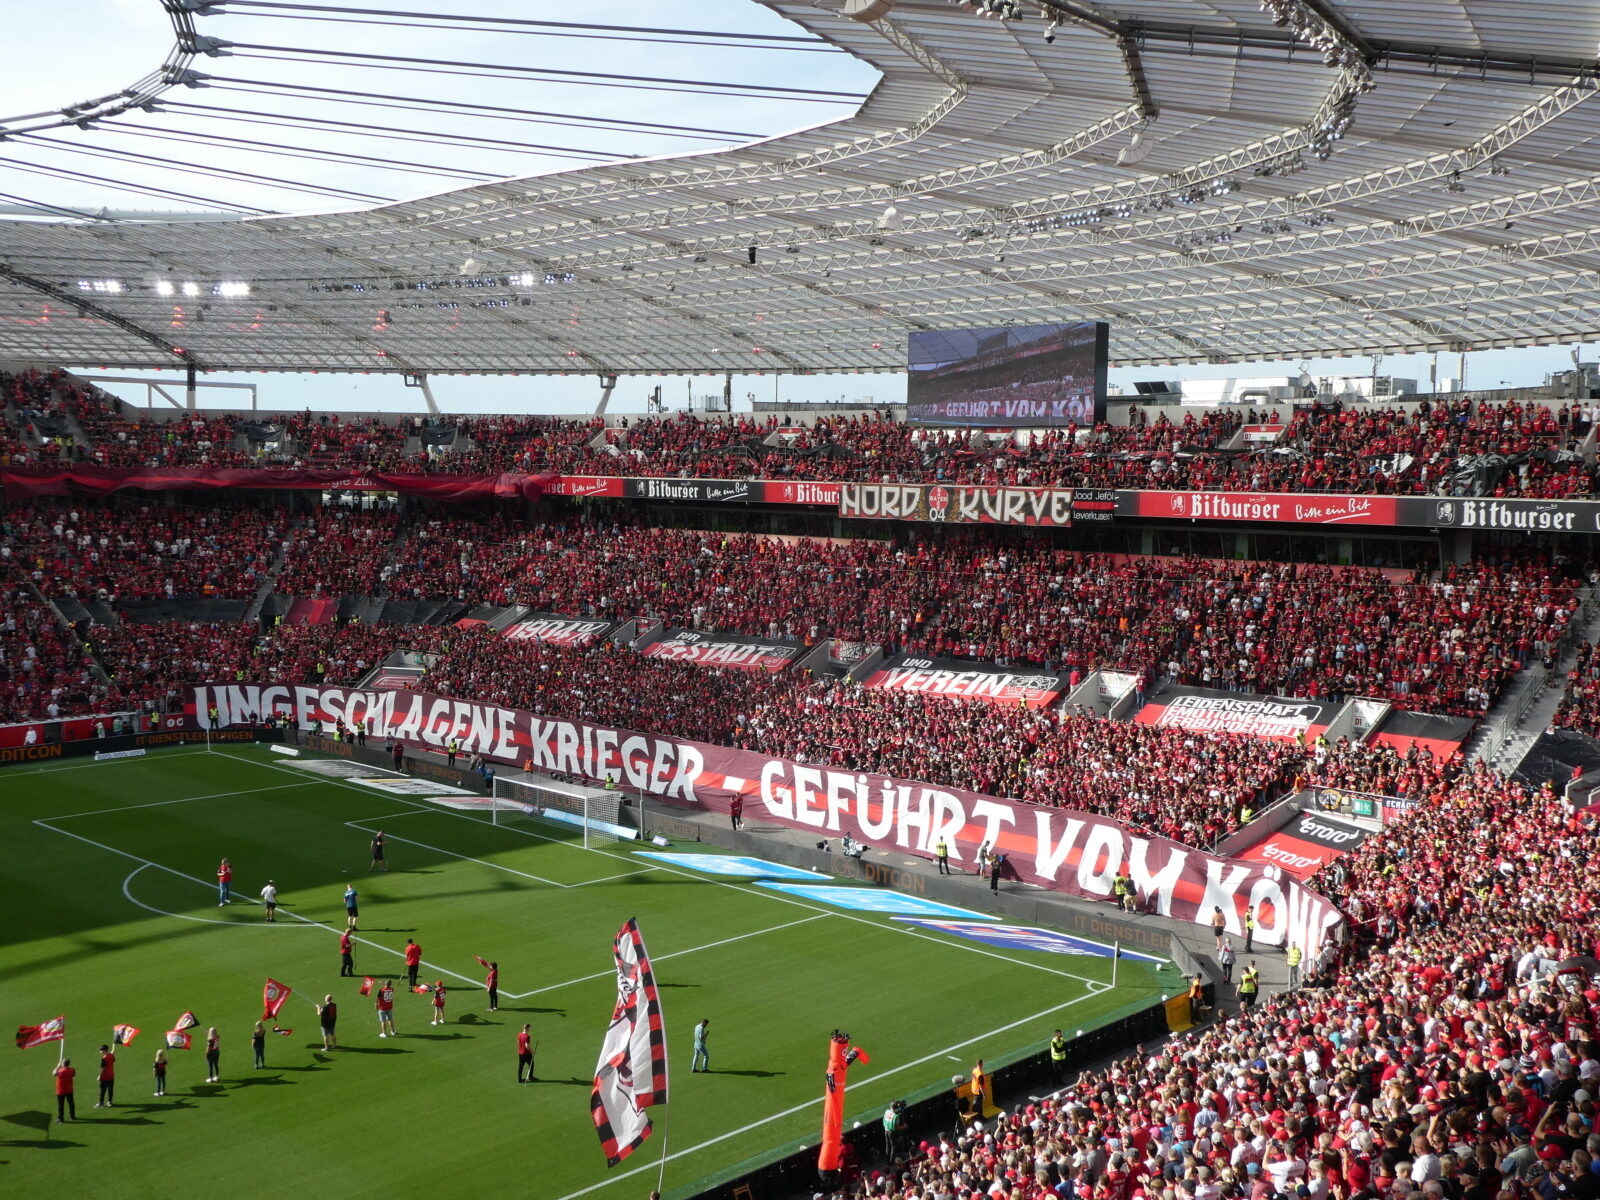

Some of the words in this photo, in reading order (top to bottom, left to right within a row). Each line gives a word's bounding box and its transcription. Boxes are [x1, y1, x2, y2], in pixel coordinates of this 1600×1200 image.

[1005, 399, 1047, 417] VOM
[648, 480, 699, 498] Bitburger
[706, 486, 722, 499] Bitte
[723, 487, 735, 495] ein
[735, 481, 749, 493] Bit
[929, 508, 945, 521] 04
[959, 489, 1072, 524] KURVE
[1190, 494, 1280, 519] Bitburger
[1296, 504, 1322, 520] Bitte
[1326, 505, 1346, 515] ein
[1348, 498, 1371, 512] Bit
[1461, 501, 1576, 530] Bitburger
[902, 658, 933, 669] UND
[884, 667, 1014, 696] VEREIN
[1167, 706, 1268, 724] EMOTIONEN
[1173, 696, 1308, 717] LEIDENSCHAFT
[1161, 715, 1304, 737] VERBUNDENHEIT
[148, 731, 254, 744] DIENSTLEISTUNGEN
[2, 744, 62, 762] DITCON
[194, 684, 519, 760] UNGESCHLAGENE
[529, 717, 704, 802] KRIEGER
[760, 760, 1016, 866] GEFÜHRT
[1034, 810, 1189, 918] VOM
[865, 863, 926, 894] DITCON
[1075, 914, 1088, 929] IT
